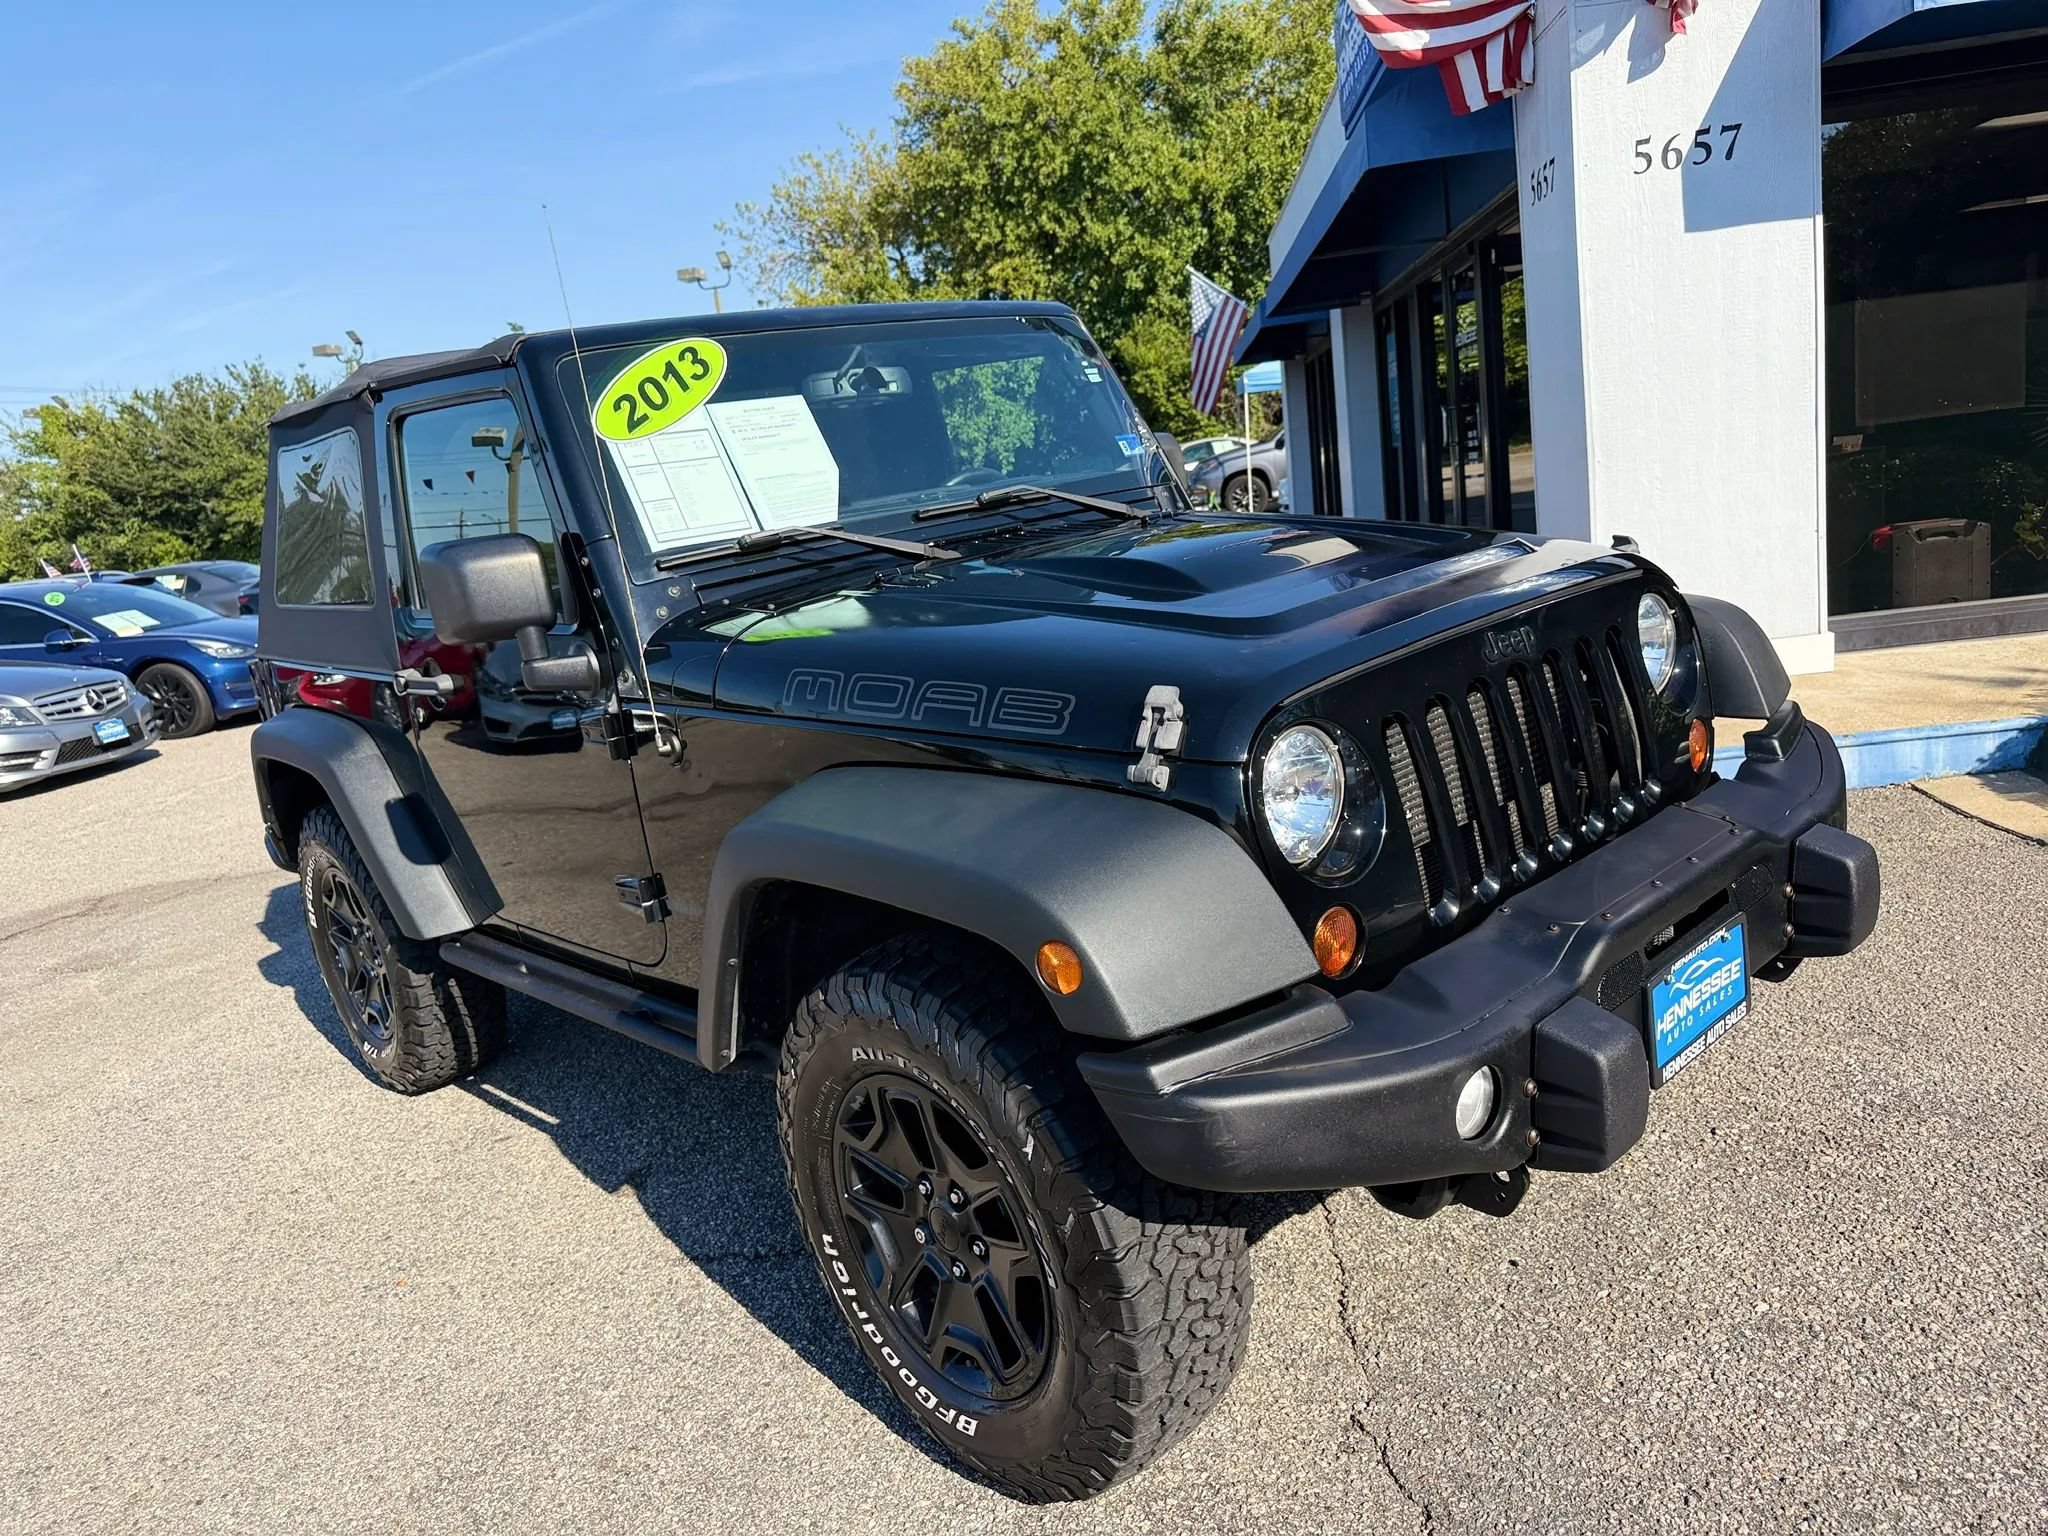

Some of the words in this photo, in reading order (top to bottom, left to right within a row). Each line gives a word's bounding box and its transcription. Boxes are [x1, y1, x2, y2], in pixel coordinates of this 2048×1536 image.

[1530, 156, 1555, 206] 5657
[1633, 121, 1743, 175] 5657
[612, 346, 709, 434] 2013
[1485, 626, 1535, 664] Jeep
[782, 668, 1076, 735] MOAB
[1656, 956, 1742, 1041] HENNESSEE
[1666, 1018, 1693, 1046] AUTO
[1699, 986, 1733, 1017] SALES
[1662, 1033, 1706, 1083] HENNESSEE
[1706, 1021, 1725, 1047] AUTO
[1725, 1001, 1747, 1032] SALES
[821, 1233, 979, 1437] BFGoodrich
